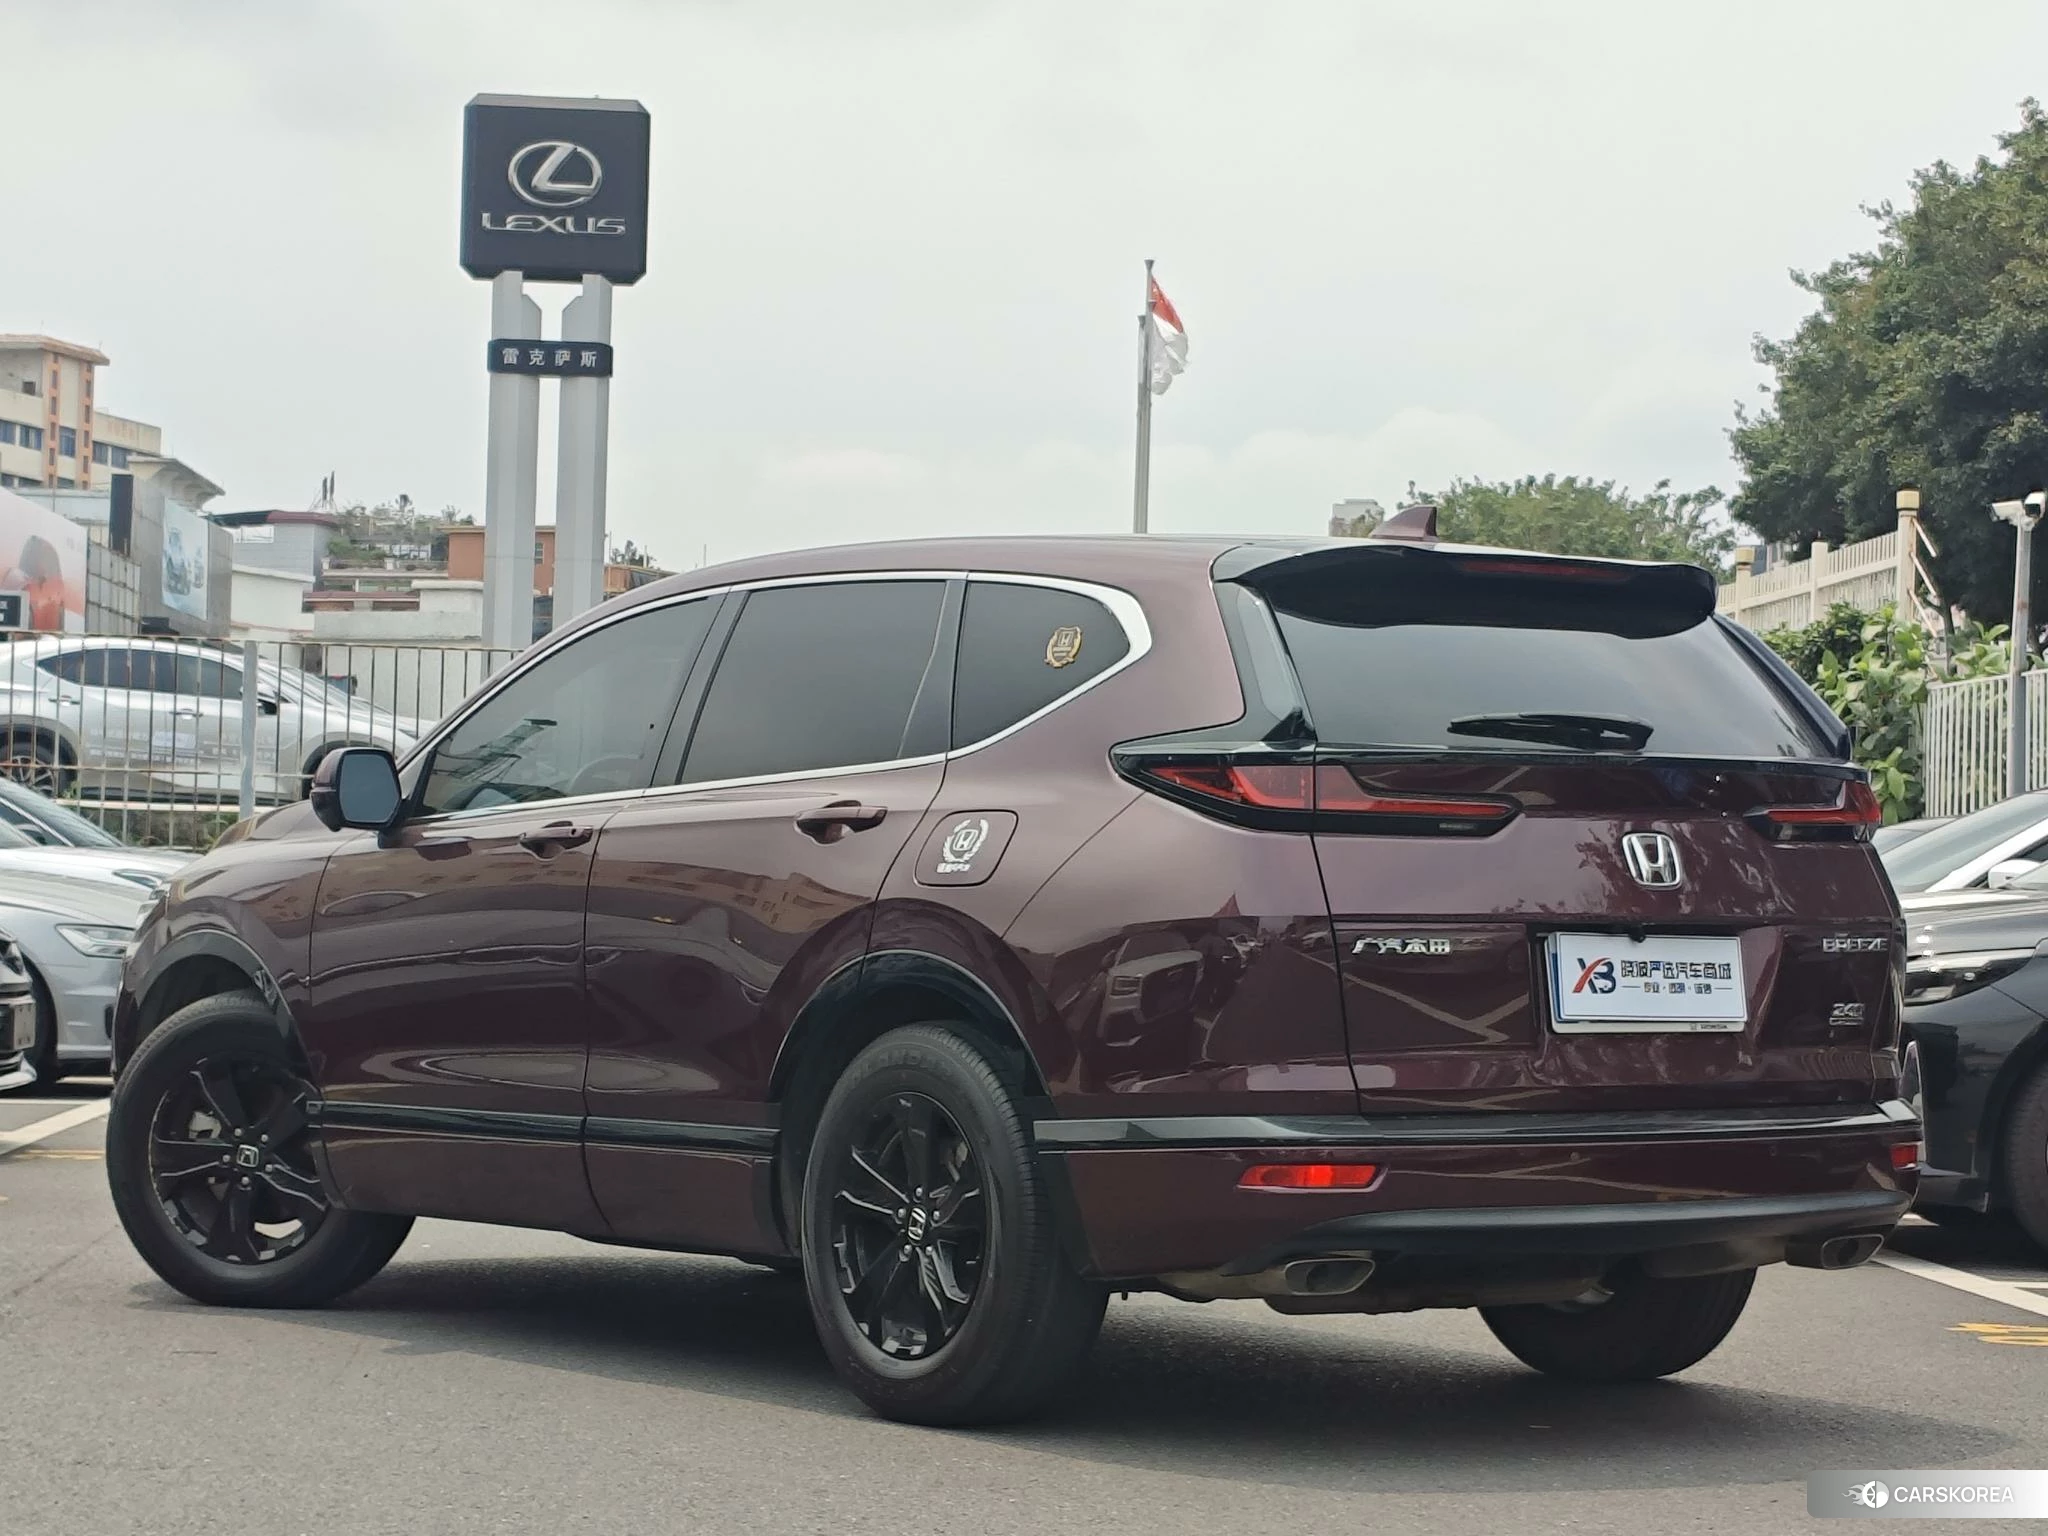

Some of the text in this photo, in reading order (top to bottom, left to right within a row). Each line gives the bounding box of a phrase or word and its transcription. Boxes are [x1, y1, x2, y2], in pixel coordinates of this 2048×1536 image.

[481, 212, 626, 234] LEXUS
[502, 347, 597, 367] 雷克萨斯
[1352, 937, 1450, 955] 广汽本田
